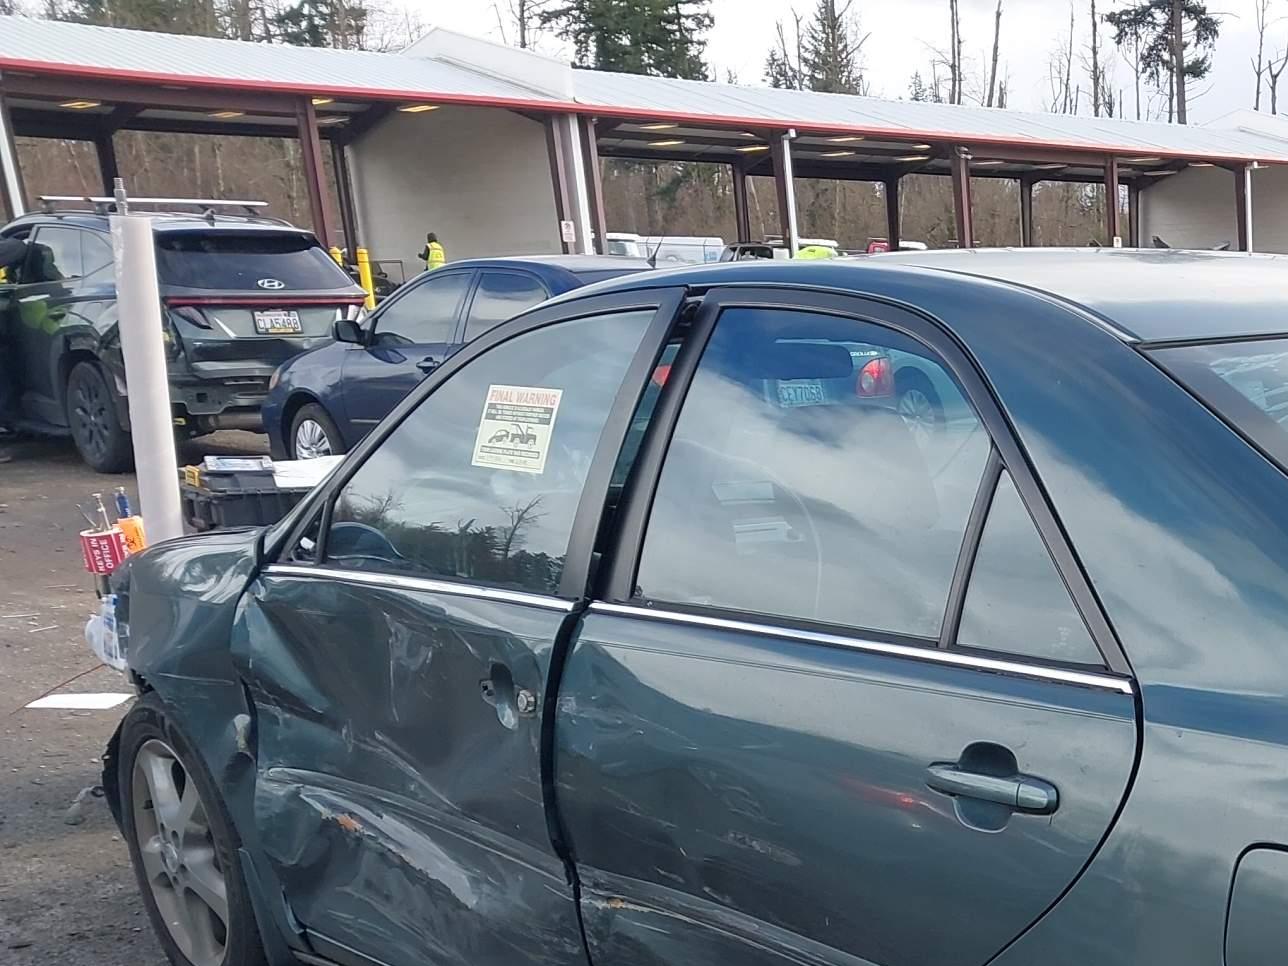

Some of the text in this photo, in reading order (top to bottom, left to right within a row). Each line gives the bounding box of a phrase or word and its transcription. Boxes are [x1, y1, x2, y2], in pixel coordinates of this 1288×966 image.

[489, 389, 558, 406] FINAL WARNING
[98, 538, 114, 569] OFFICE
